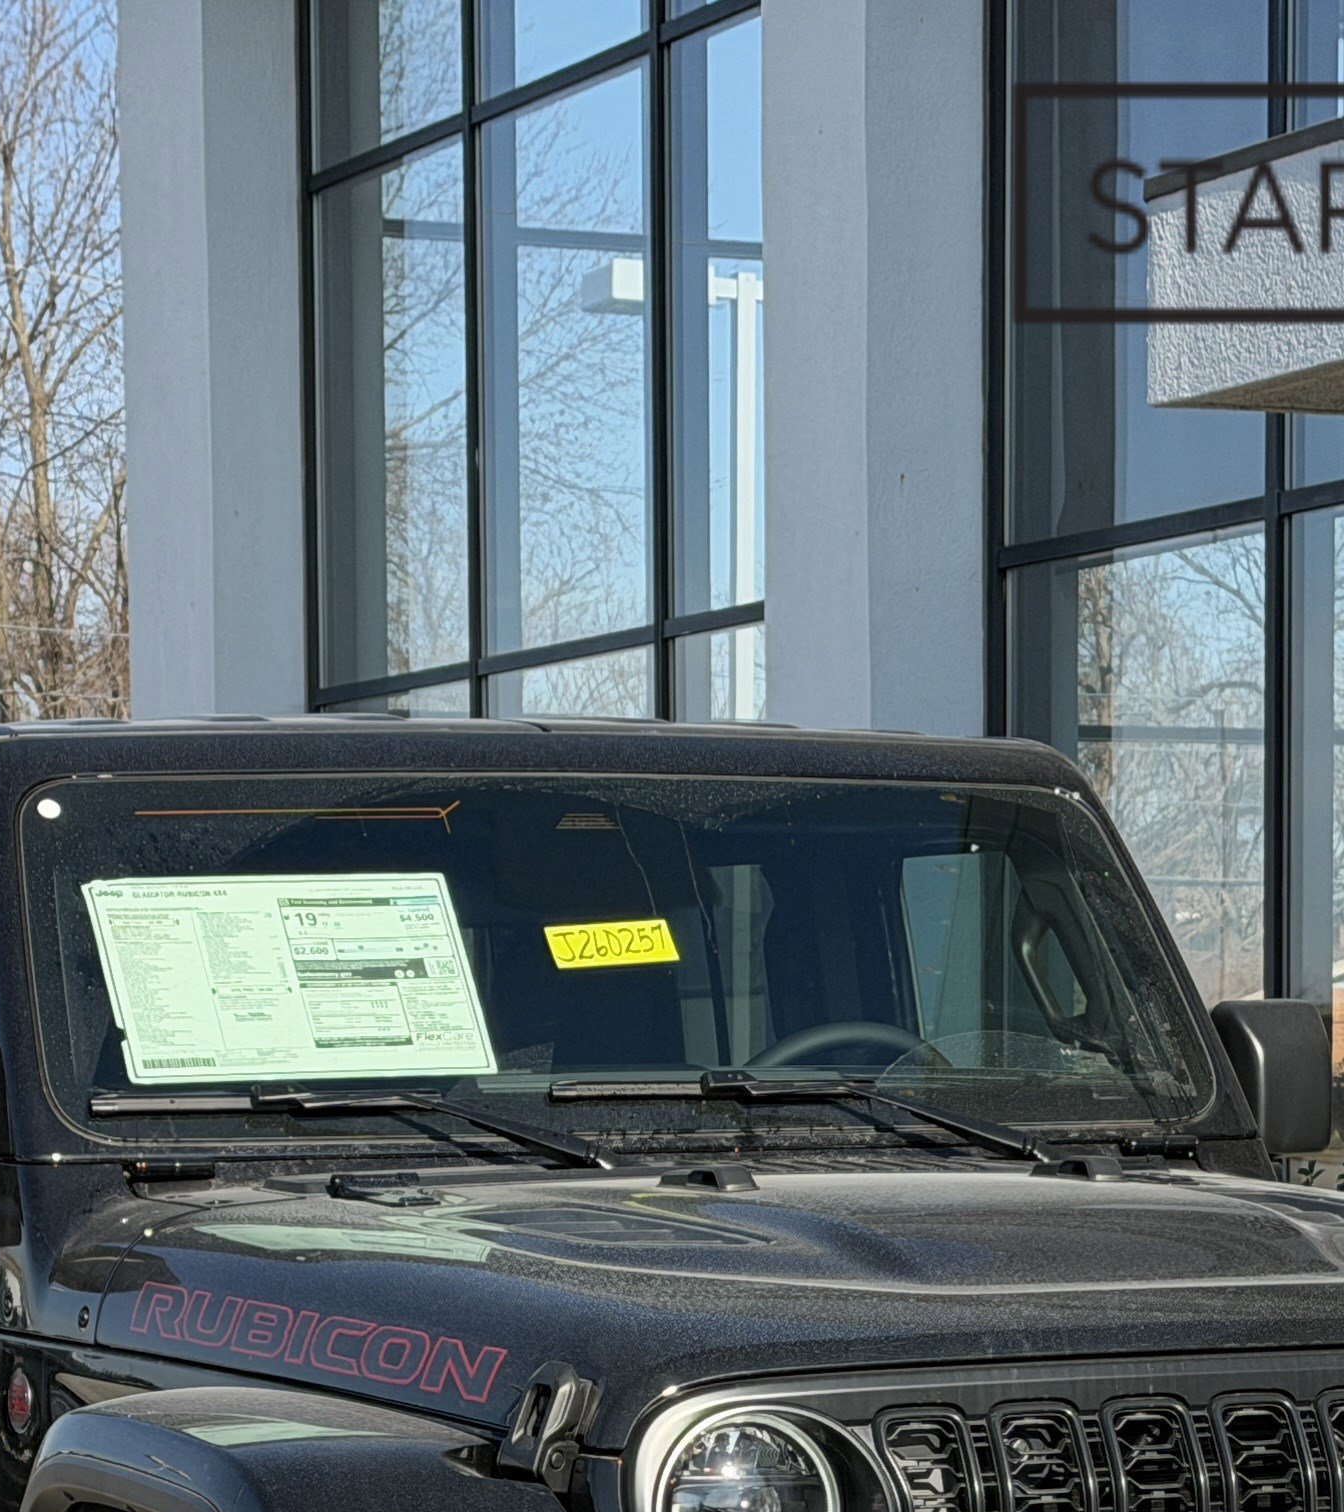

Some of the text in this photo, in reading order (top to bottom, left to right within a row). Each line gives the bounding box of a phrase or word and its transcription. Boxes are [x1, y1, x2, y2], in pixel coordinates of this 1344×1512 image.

[294, 912, 317, 926] 19
[553, 923, 667, 963] J260257
[416, 1031, 474, 1042] FlexCare
[129, 1281, 508, 1404] RUBICON
